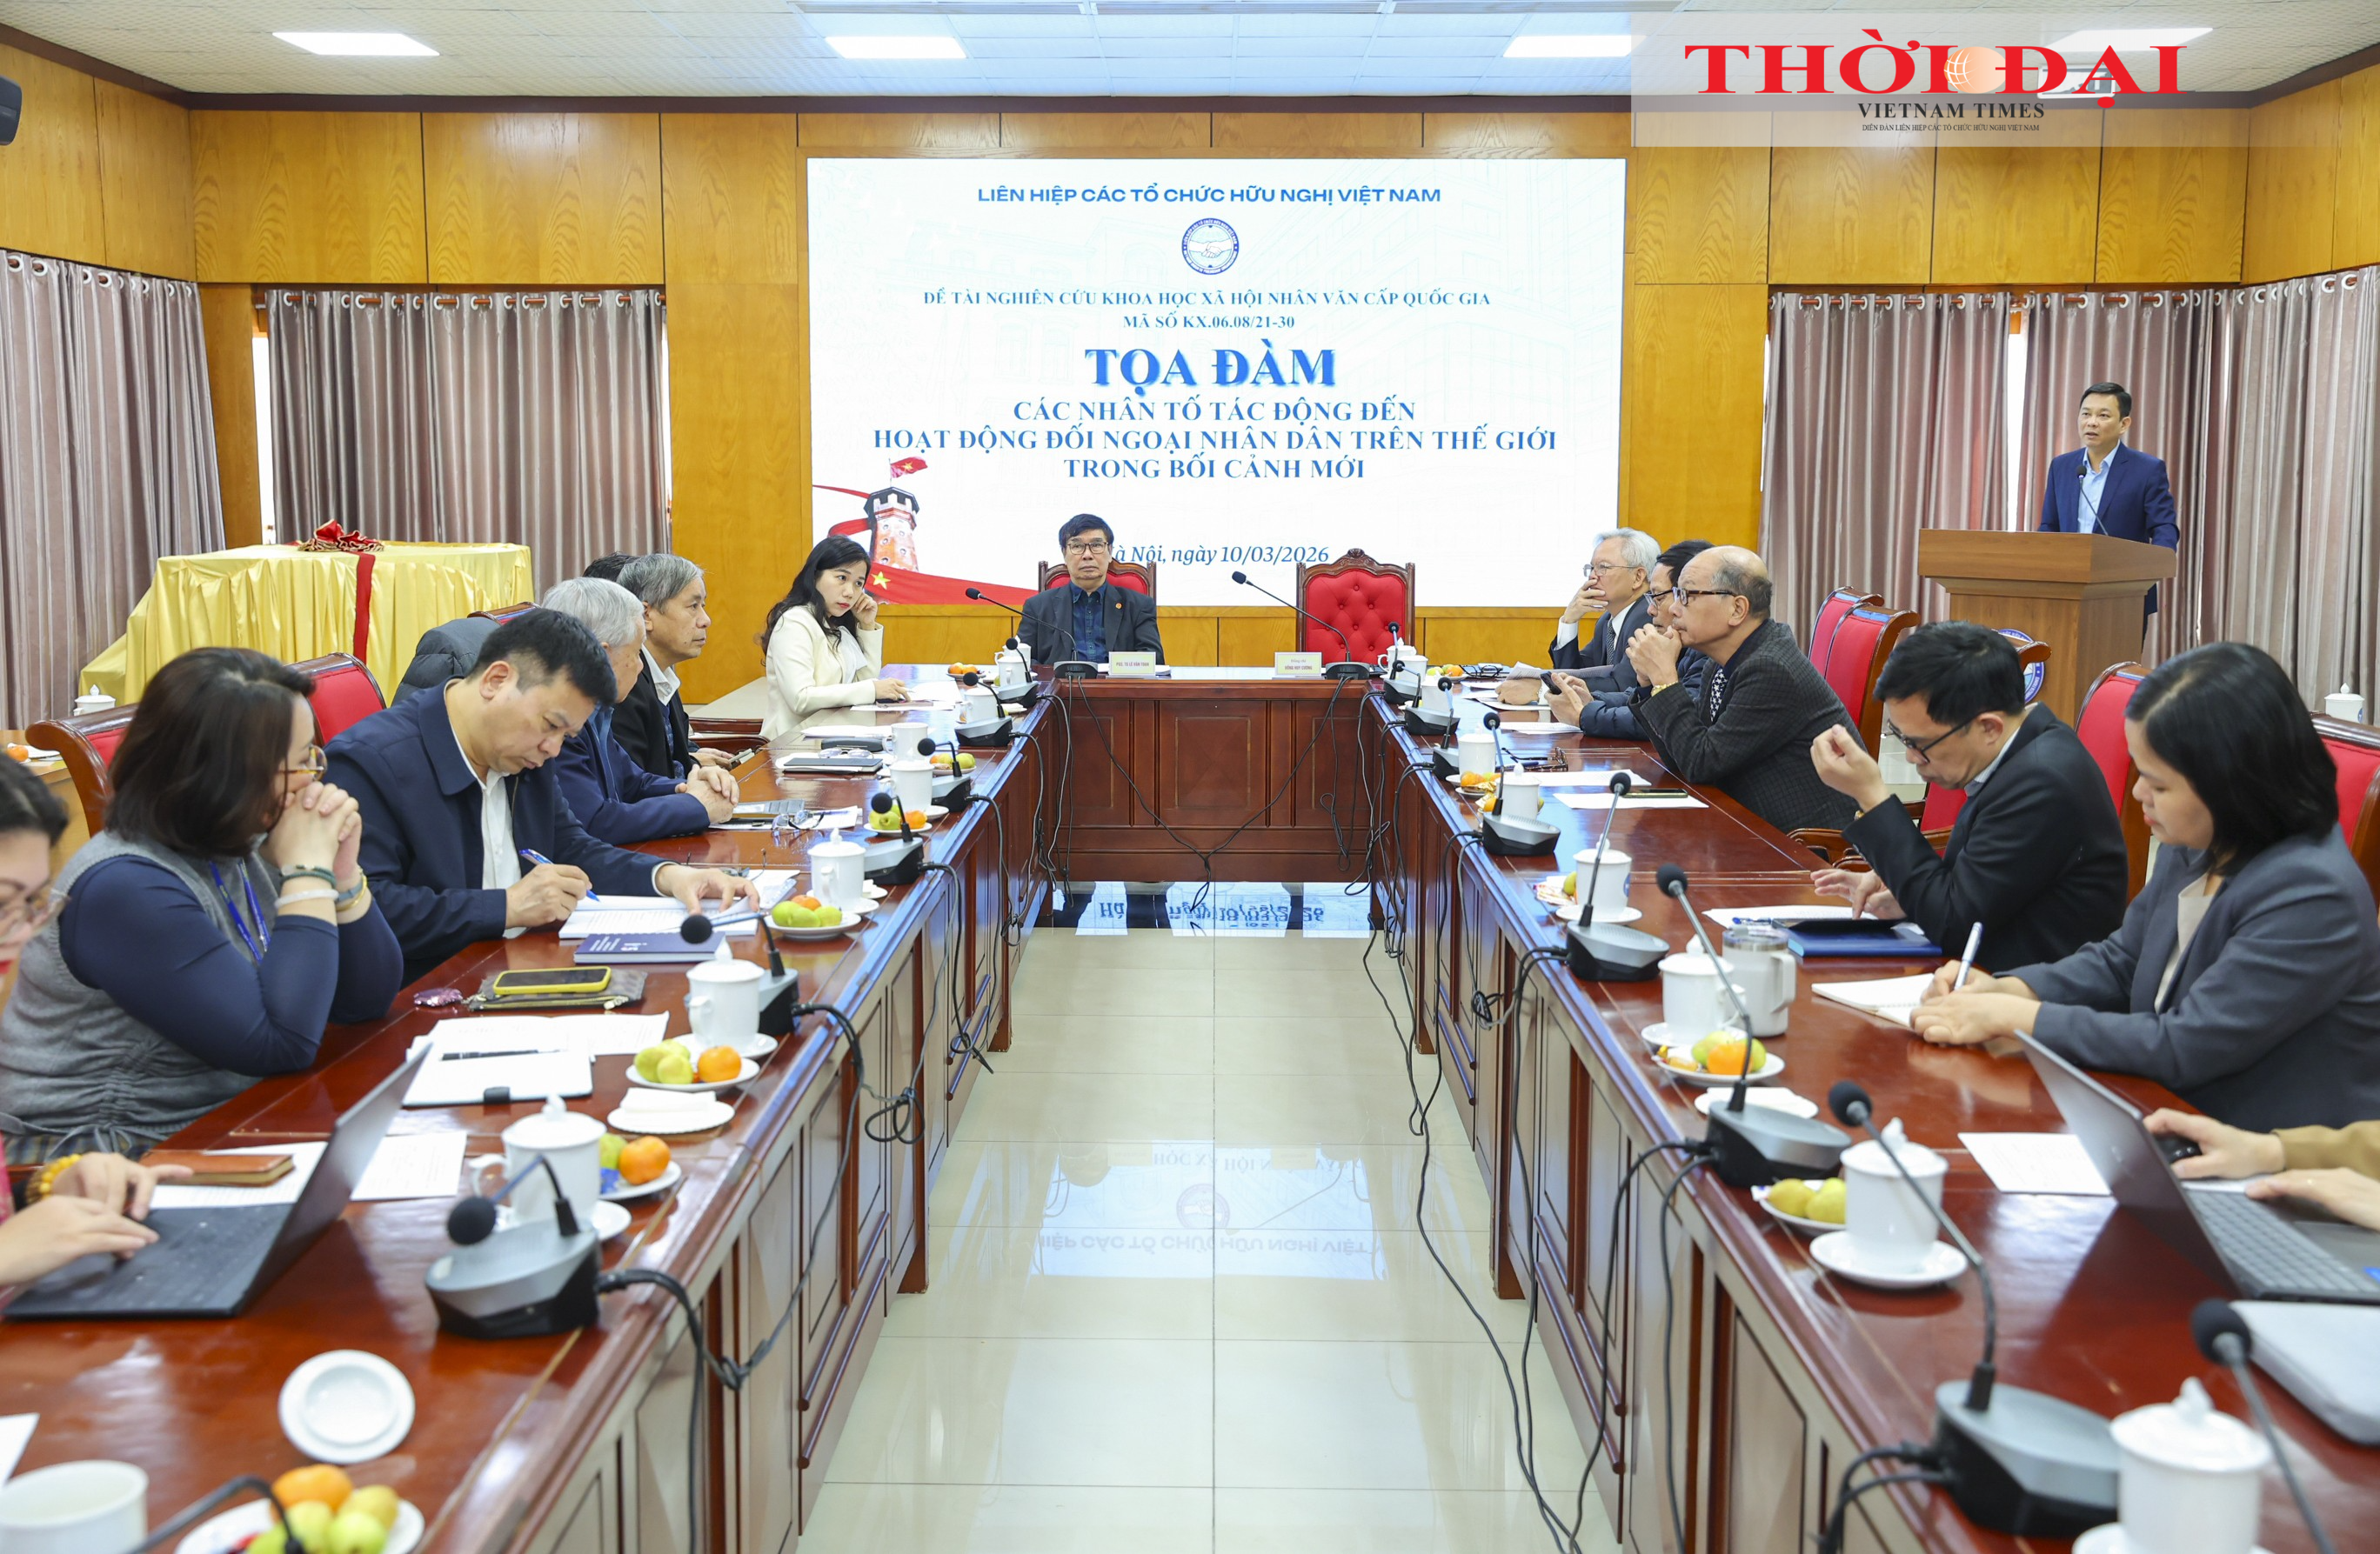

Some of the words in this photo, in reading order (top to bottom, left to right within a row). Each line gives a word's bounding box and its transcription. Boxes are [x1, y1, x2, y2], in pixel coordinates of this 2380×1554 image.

[979, 185, 1025, 202] LIÊN
[1030, 185, 1077, 205] HIỆP
[1081, 185, 1126, 202] CÁC
[1131, 183, 1159, 202] TỔ
[1164, 185, 1225, 202] CHỨC
[1231, 185, 1275, 202] HỮU
[1281, 189, 1334, 205] NGHỊ
[1338, 185, 1385, 205] VIỆT
[1389, 189, 1441, 202] NAM
[924, 288, 946, 304] ĐỀ
[952, 290, 980, 304] TÀI
[986, 290, 1053, 304] NGHIÊN
[1060, 290, 1097, 305] CỨU
[1102, 292, 1153, 305] KHOA
[1159, 292, 1197, 308] HỌC
[1201, 290, 1225, 305] XÃ
[1231, 290, 1262, 308] HỘI
[1268, 290, 1318, 305] NHÂN
[1323, 290, 1359, 305] VĂN
[1364, 288, 1399, 305] CẤP
[1403, 288, 1454, 308] QUỐC
[1459, 292, 1490, 305] GIA
[1123, 314, 1150, 329] MÃ
[1155, 311, 1178, 329] SỐ
[1183, 316, 1295, 329] KX.06.08/21-30
[1085, 349, 1197, 397] TỌA
[1211, 339, 1336, 387] ĐÀM
[1013, 397, 1071, 421] CÁC
[1079, 397, 1155, 421] NHÂN
[1164, 394, 1201, 421] TỐ
[1209, 397, 1265, 421] TÁC
[1274, 397, 1352, 426] ĐỘNG
[1360, 395, 1415, 421] ĐẾN
[874, 430, 951, 454] HOẠT
[959, 425, 1037, 454] ĐỘNG
[1046, 424, 1093, 450] ĐỐI
[1103, 430, 1191, 455] NGOẠI
[1200, 425, 1277, 450] NHÂN
[1287, 425, 1342, 450] DÂN
[1350, 425, 1424, 450] TRÊN
[1432, 424, 1488, 450] THẾ
[1495, 425, 1555, 450] GIỚI
[1064, 459, 1160, 478] TRONG
[1170, 452, 1214, 478] BỐI
[1224, 454, 1301, 478] CẢNH
[1311, 454, 1364, 478] MỚI
[1113, 545, 1126, 563] à
[1172, 545, 1218, 566] ngày
[1220, 546, 1329, 565] 10/03/2026
